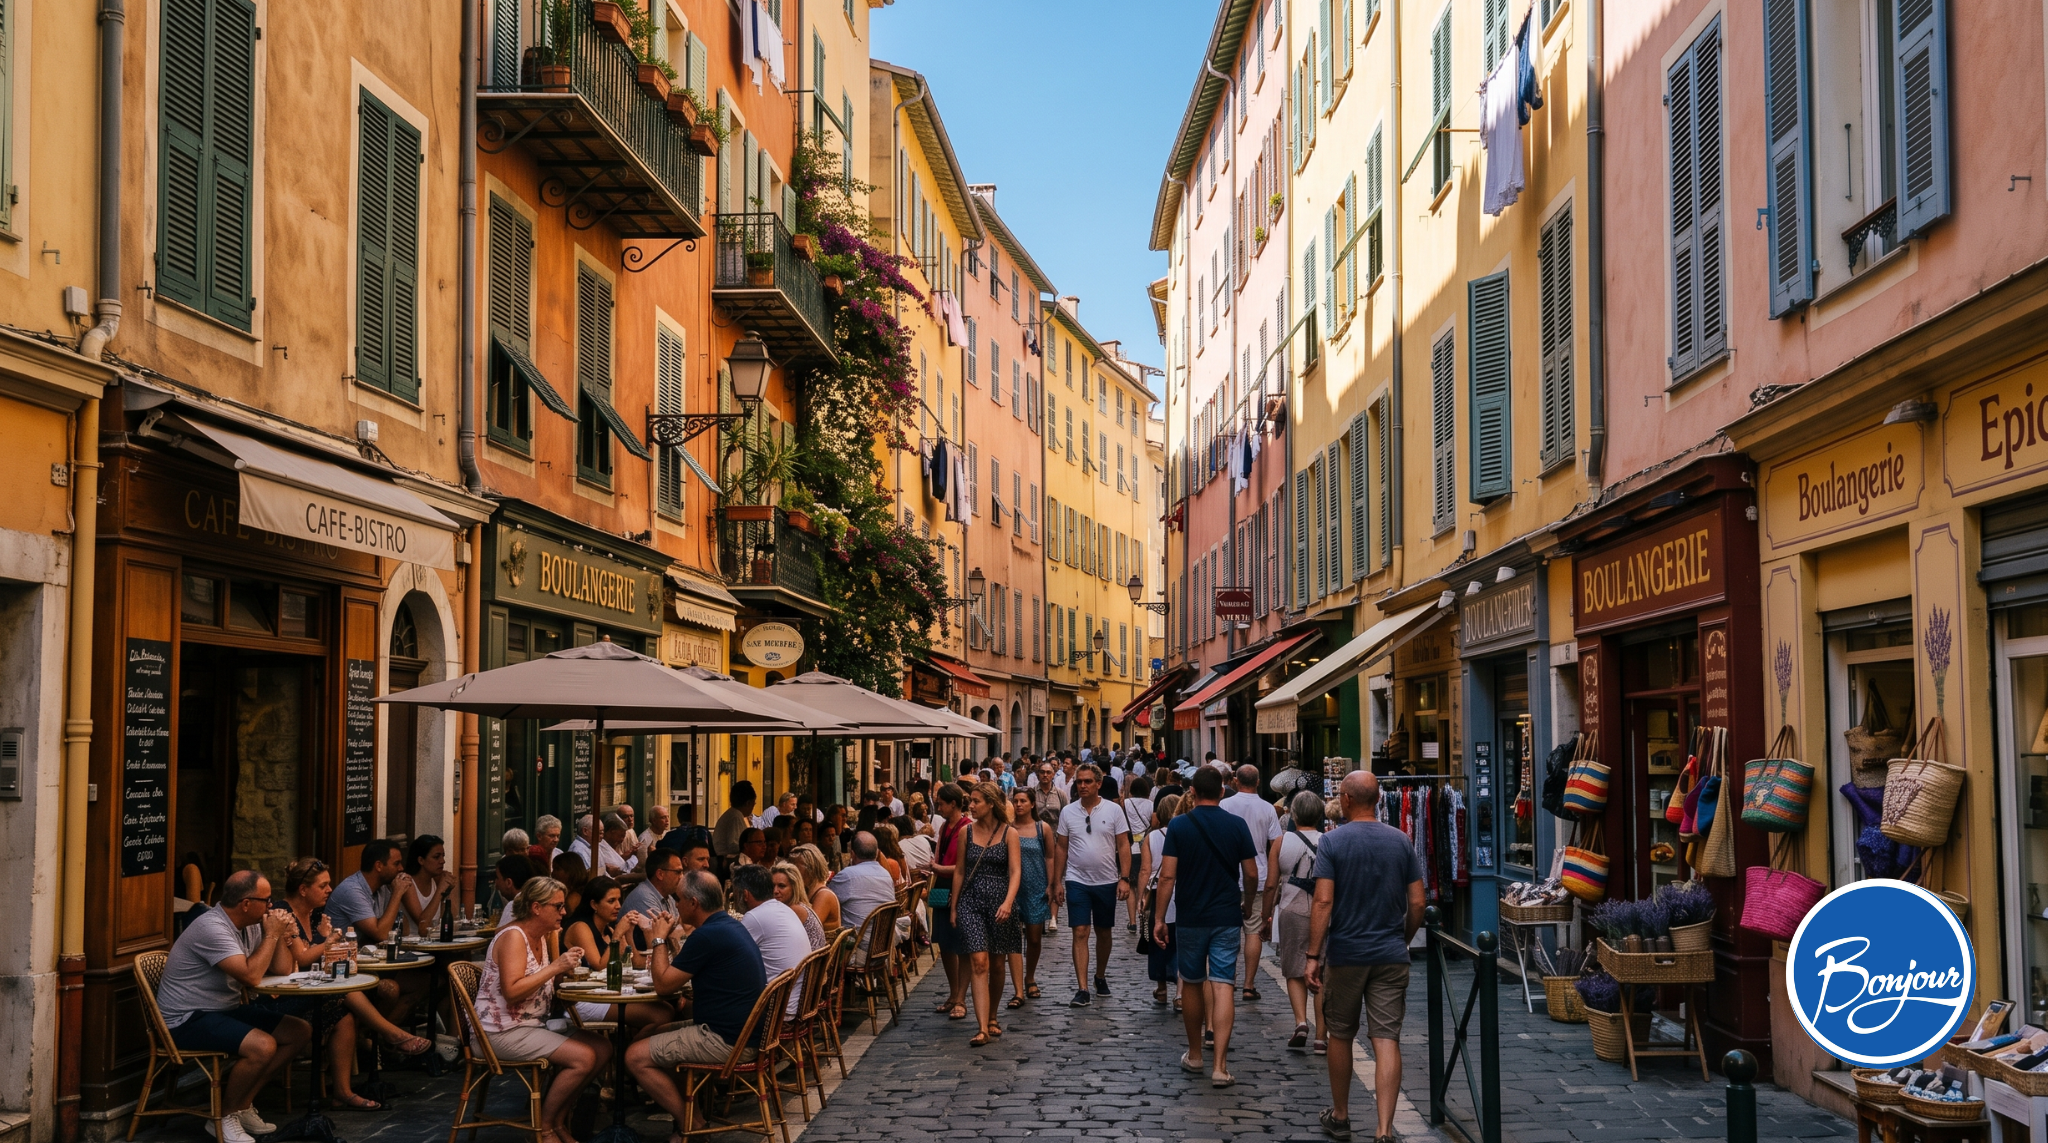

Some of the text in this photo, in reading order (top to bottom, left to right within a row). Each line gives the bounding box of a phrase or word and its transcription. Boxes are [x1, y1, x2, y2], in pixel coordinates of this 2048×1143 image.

[1797, 441, 1905, 522] Boulangerie
[306, 502, 406, 553] CAFE-BISTRO
[541, 551, 636, 613] BOULANGERIE
[1583, 528, 1711, 614] BOULANGERIE
